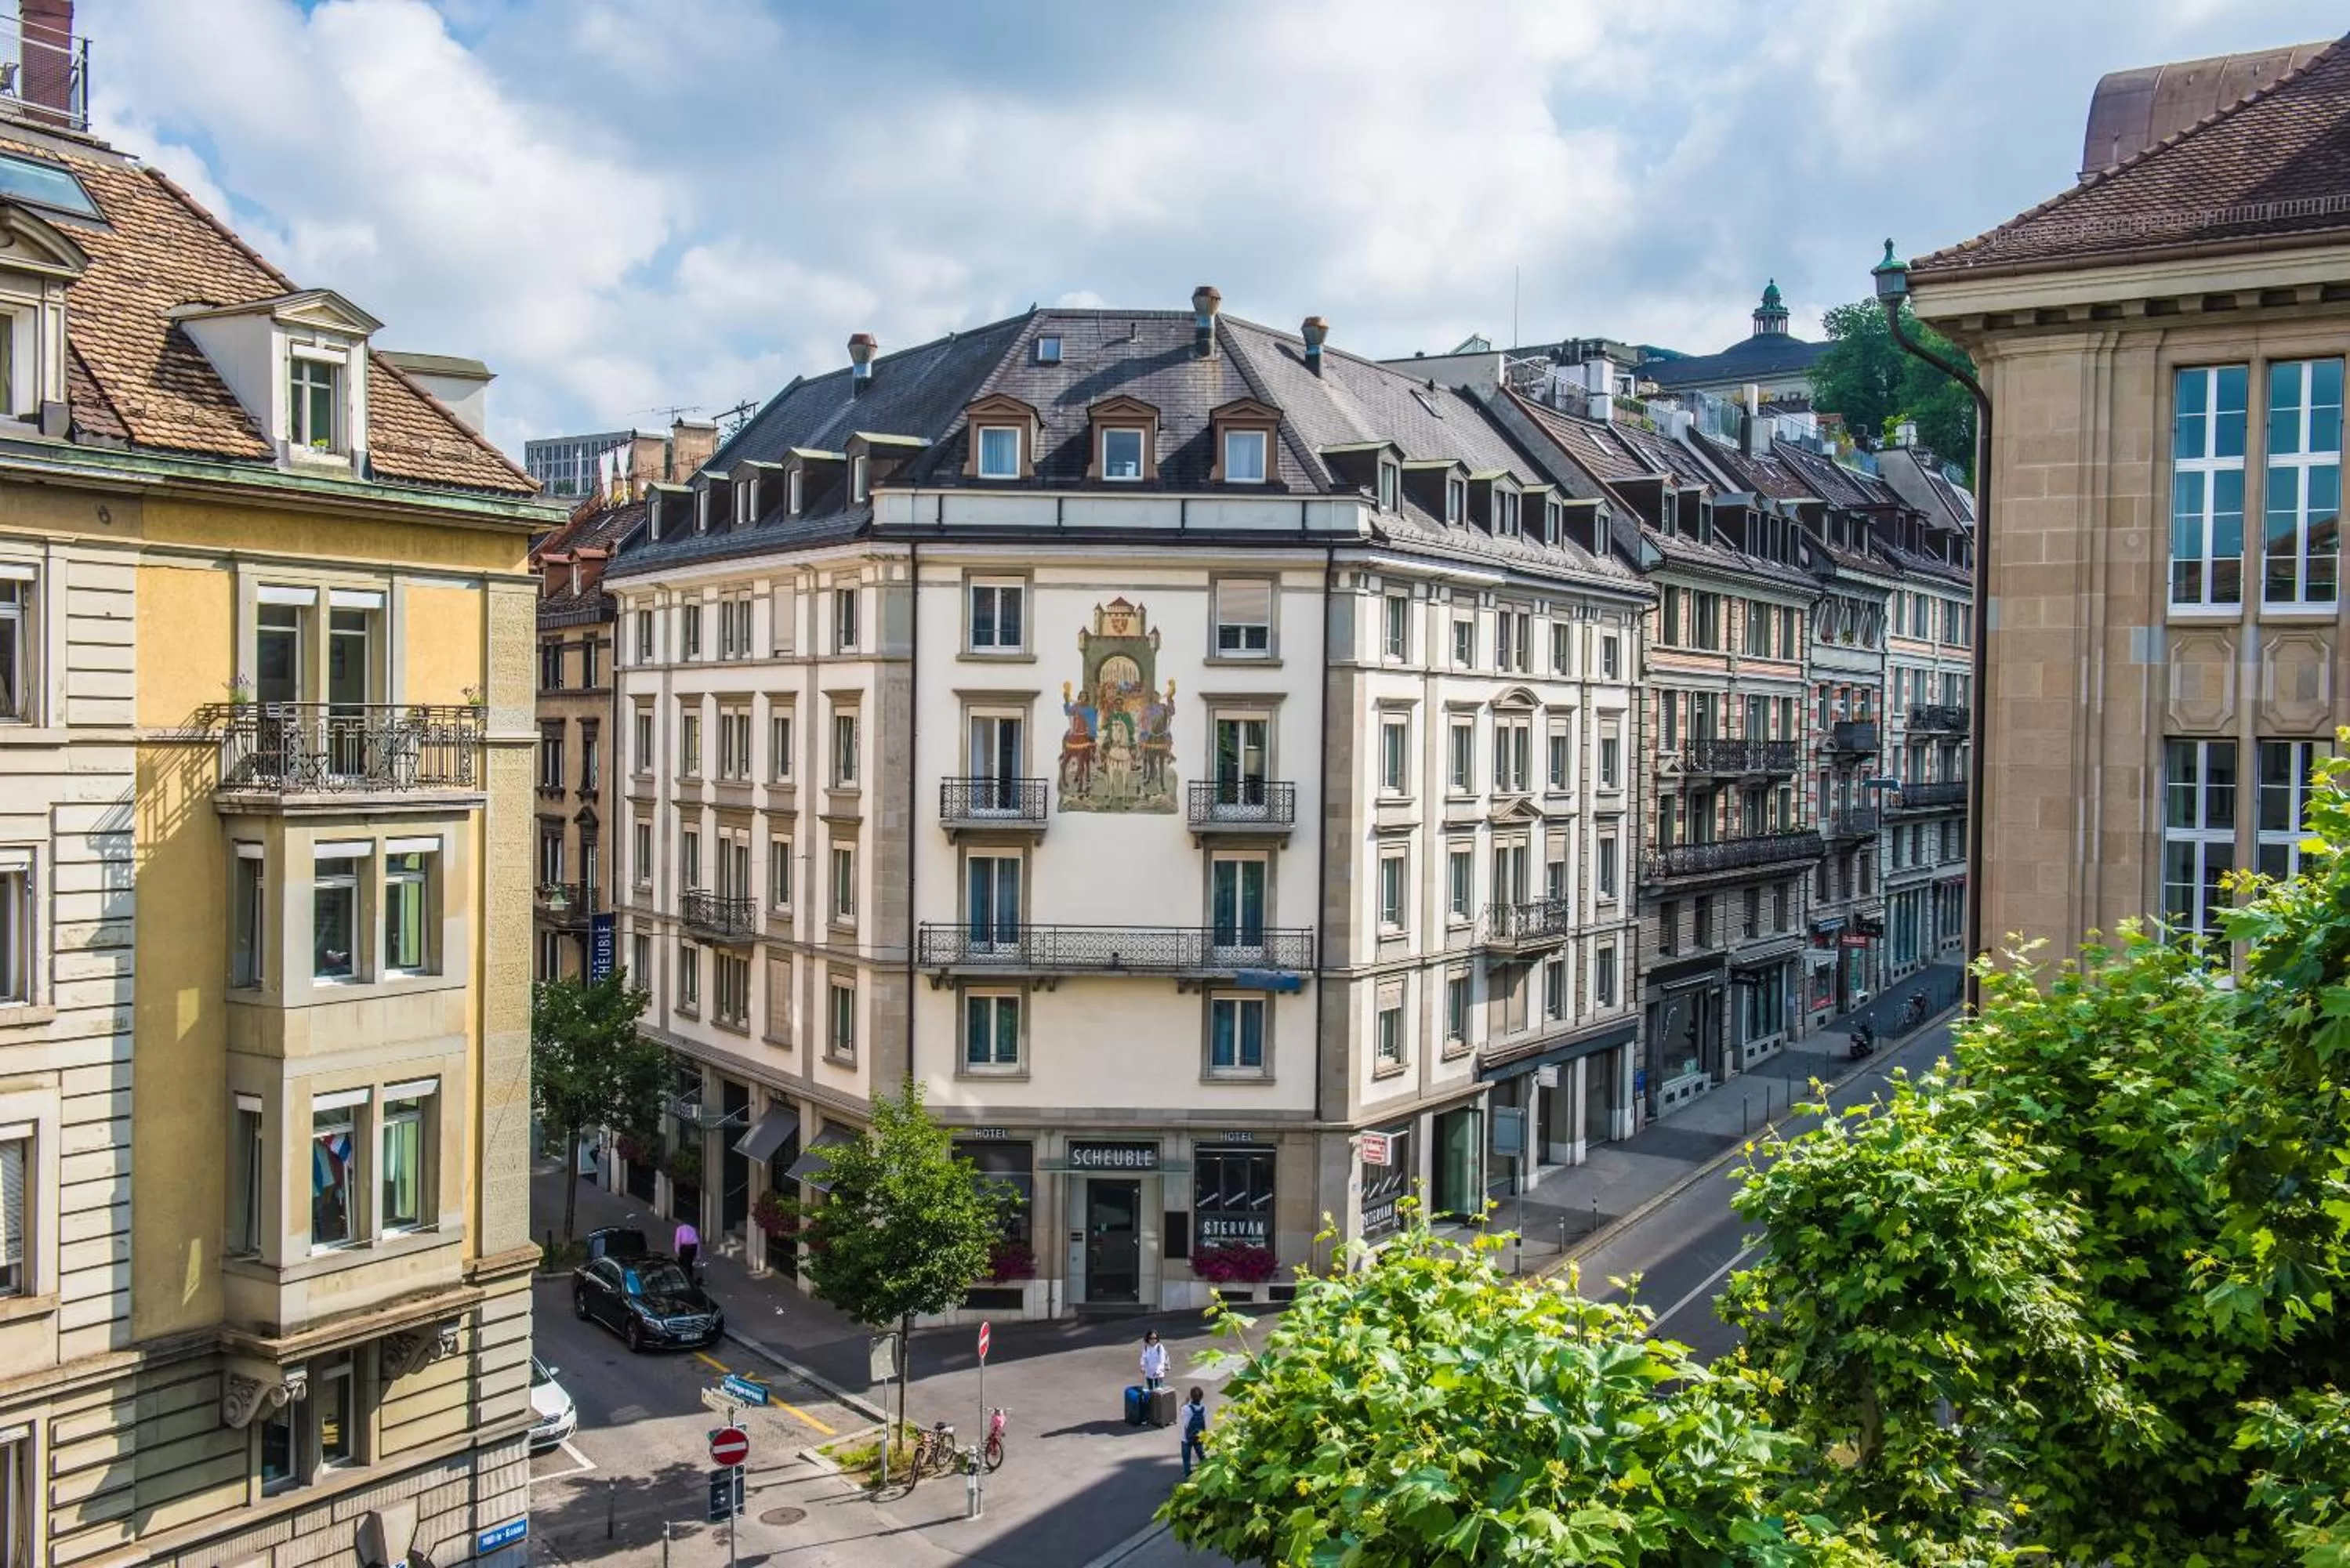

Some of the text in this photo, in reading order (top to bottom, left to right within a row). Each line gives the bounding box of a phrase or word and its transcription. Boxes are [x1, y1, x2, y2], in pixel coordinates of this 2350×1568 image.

[975, 1129, 1006, 1139] HOTEL
[1220, 1132, 1253, 1141] HOTEL
[1073, 1149, 1152, 1166] SCHEUBLE
[1203, 1221, 1264, 1235] STERVAN
